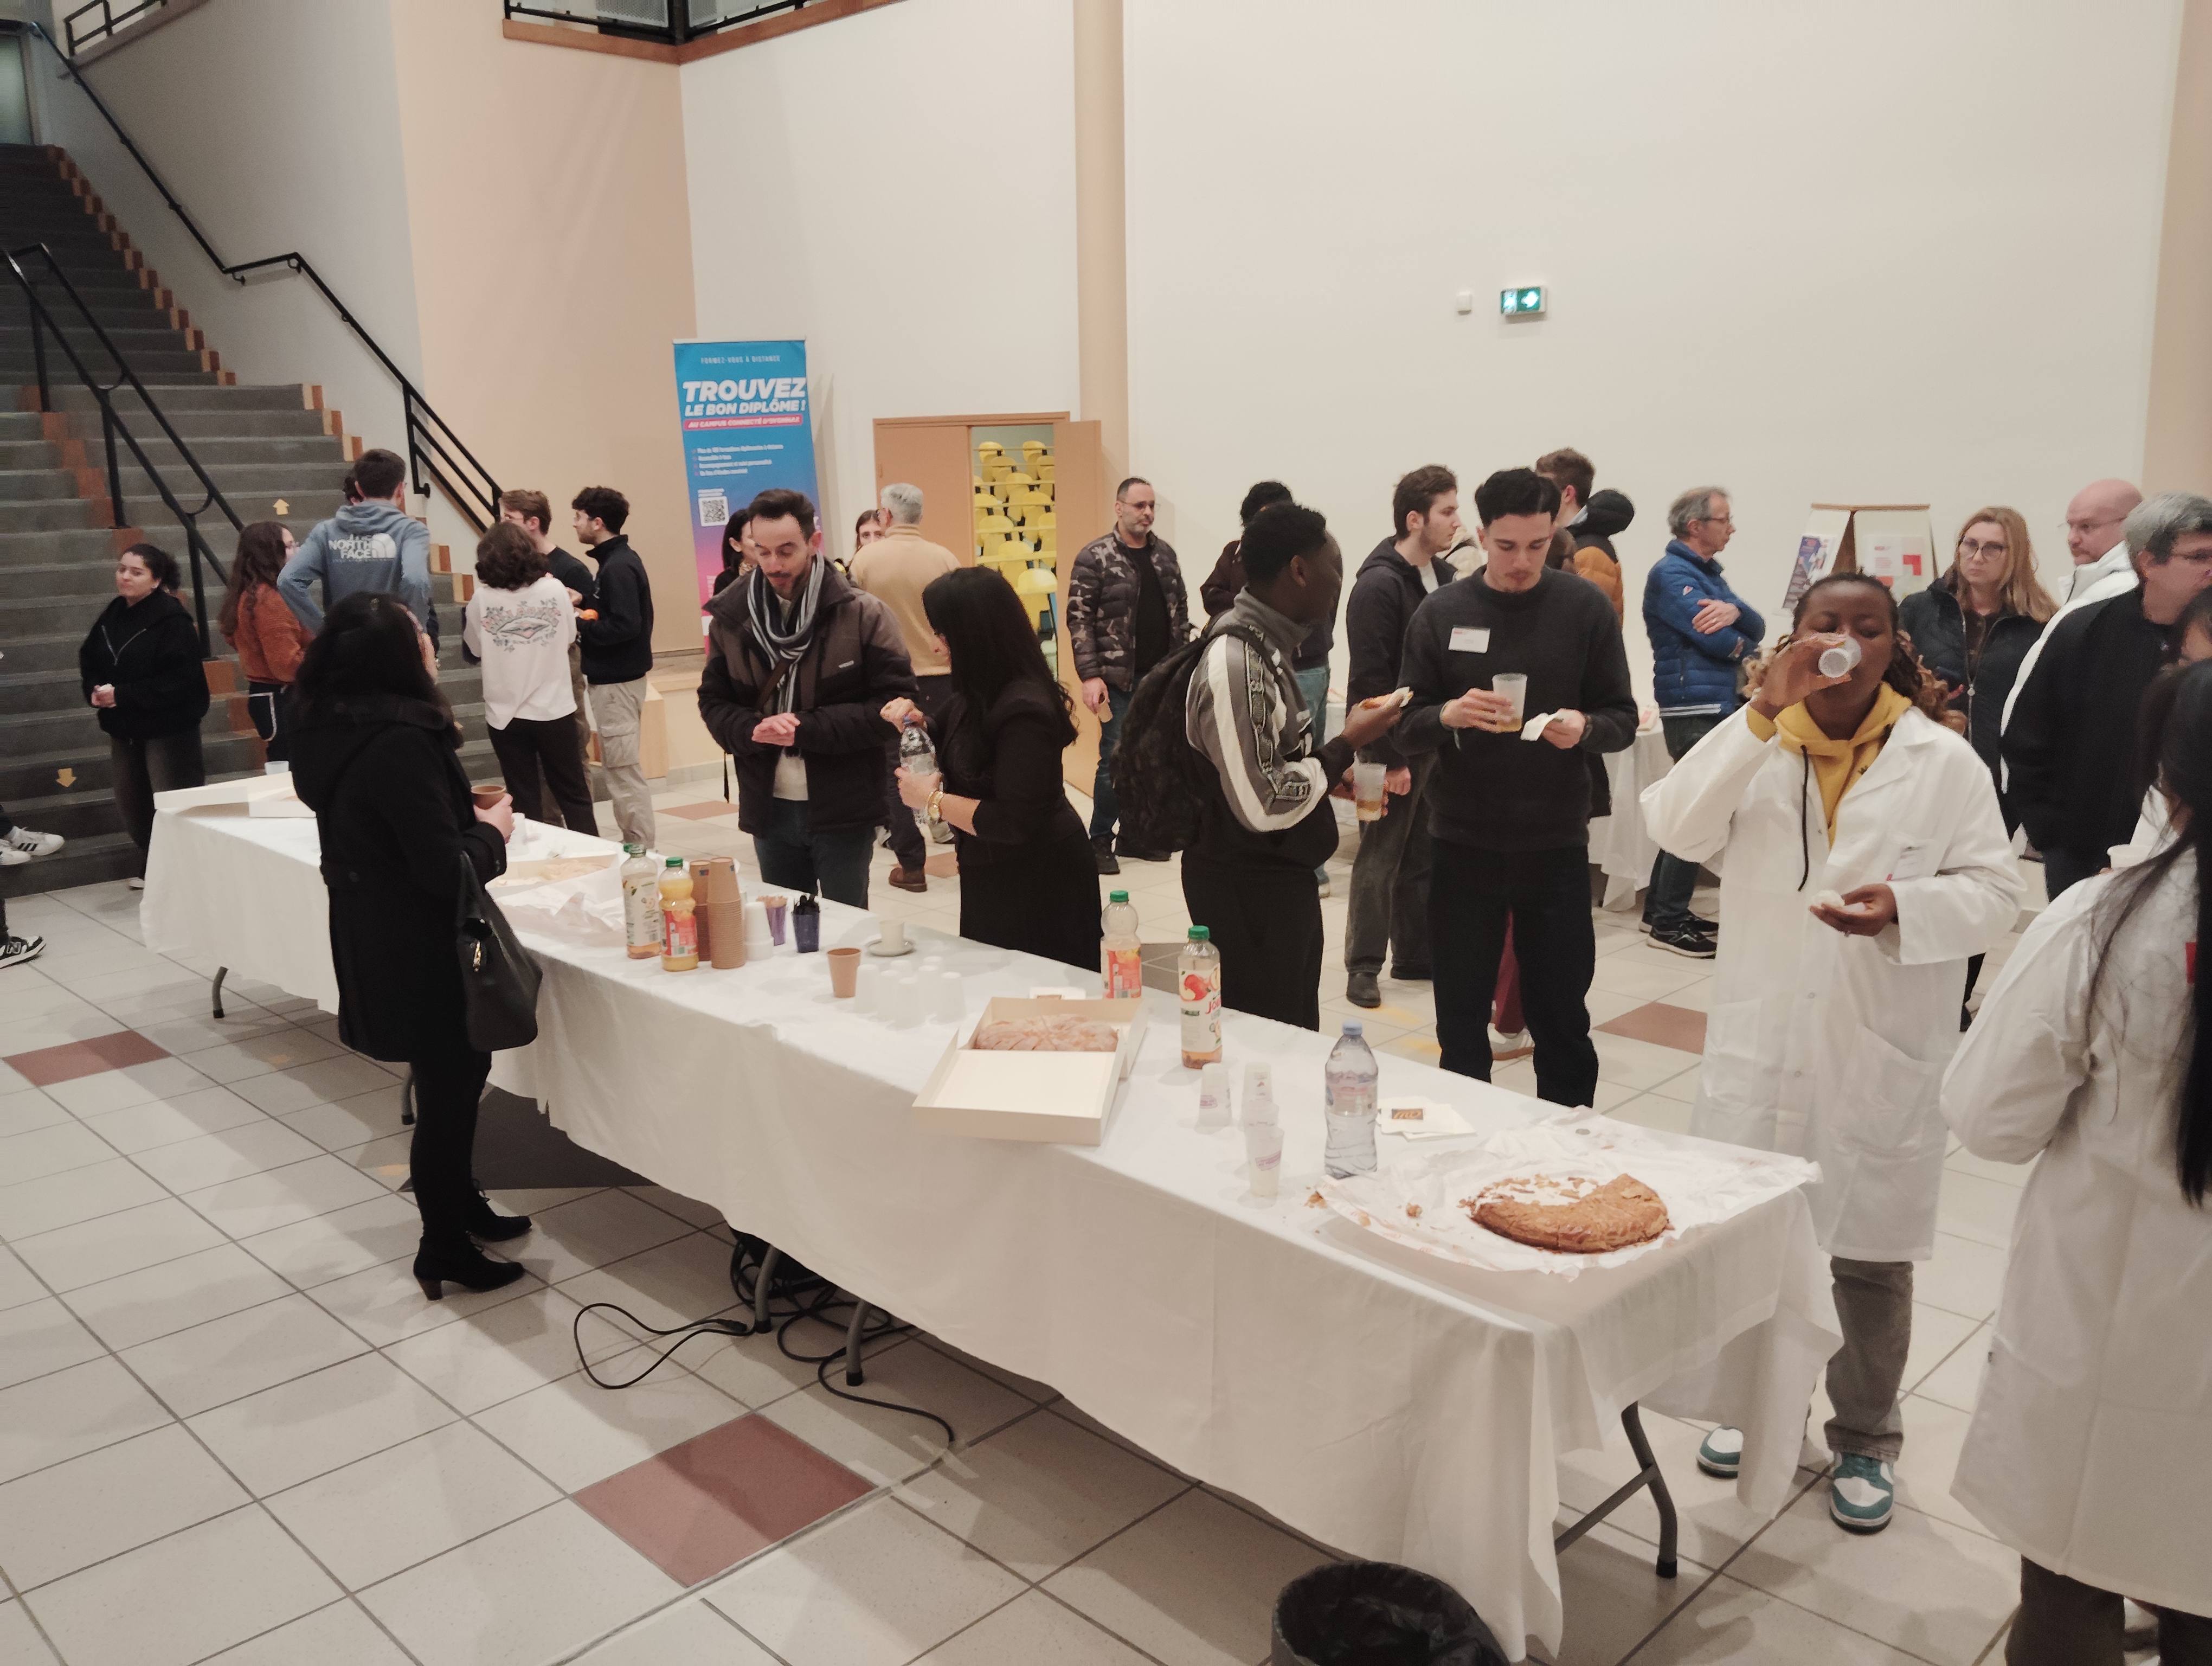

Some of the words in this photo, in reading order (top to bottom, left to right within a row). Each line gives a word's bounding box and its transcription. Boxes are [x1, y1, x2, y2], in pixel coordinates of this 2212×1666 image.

[683, 377, 807, 402] TROUVEZ
[685, 403, 704, 416] LE
[705, 402, 737, 416] BON
[739, 399, 800, 415] DIPLÔME
[801, 399, 806, 411] !
[699, 420, 727, 428] CAMPUS
[728, 417, 761, 427] CONNECTÉ
[329, 539, 371, 550] NORTH
[340, 549, 371, 559] FACE
